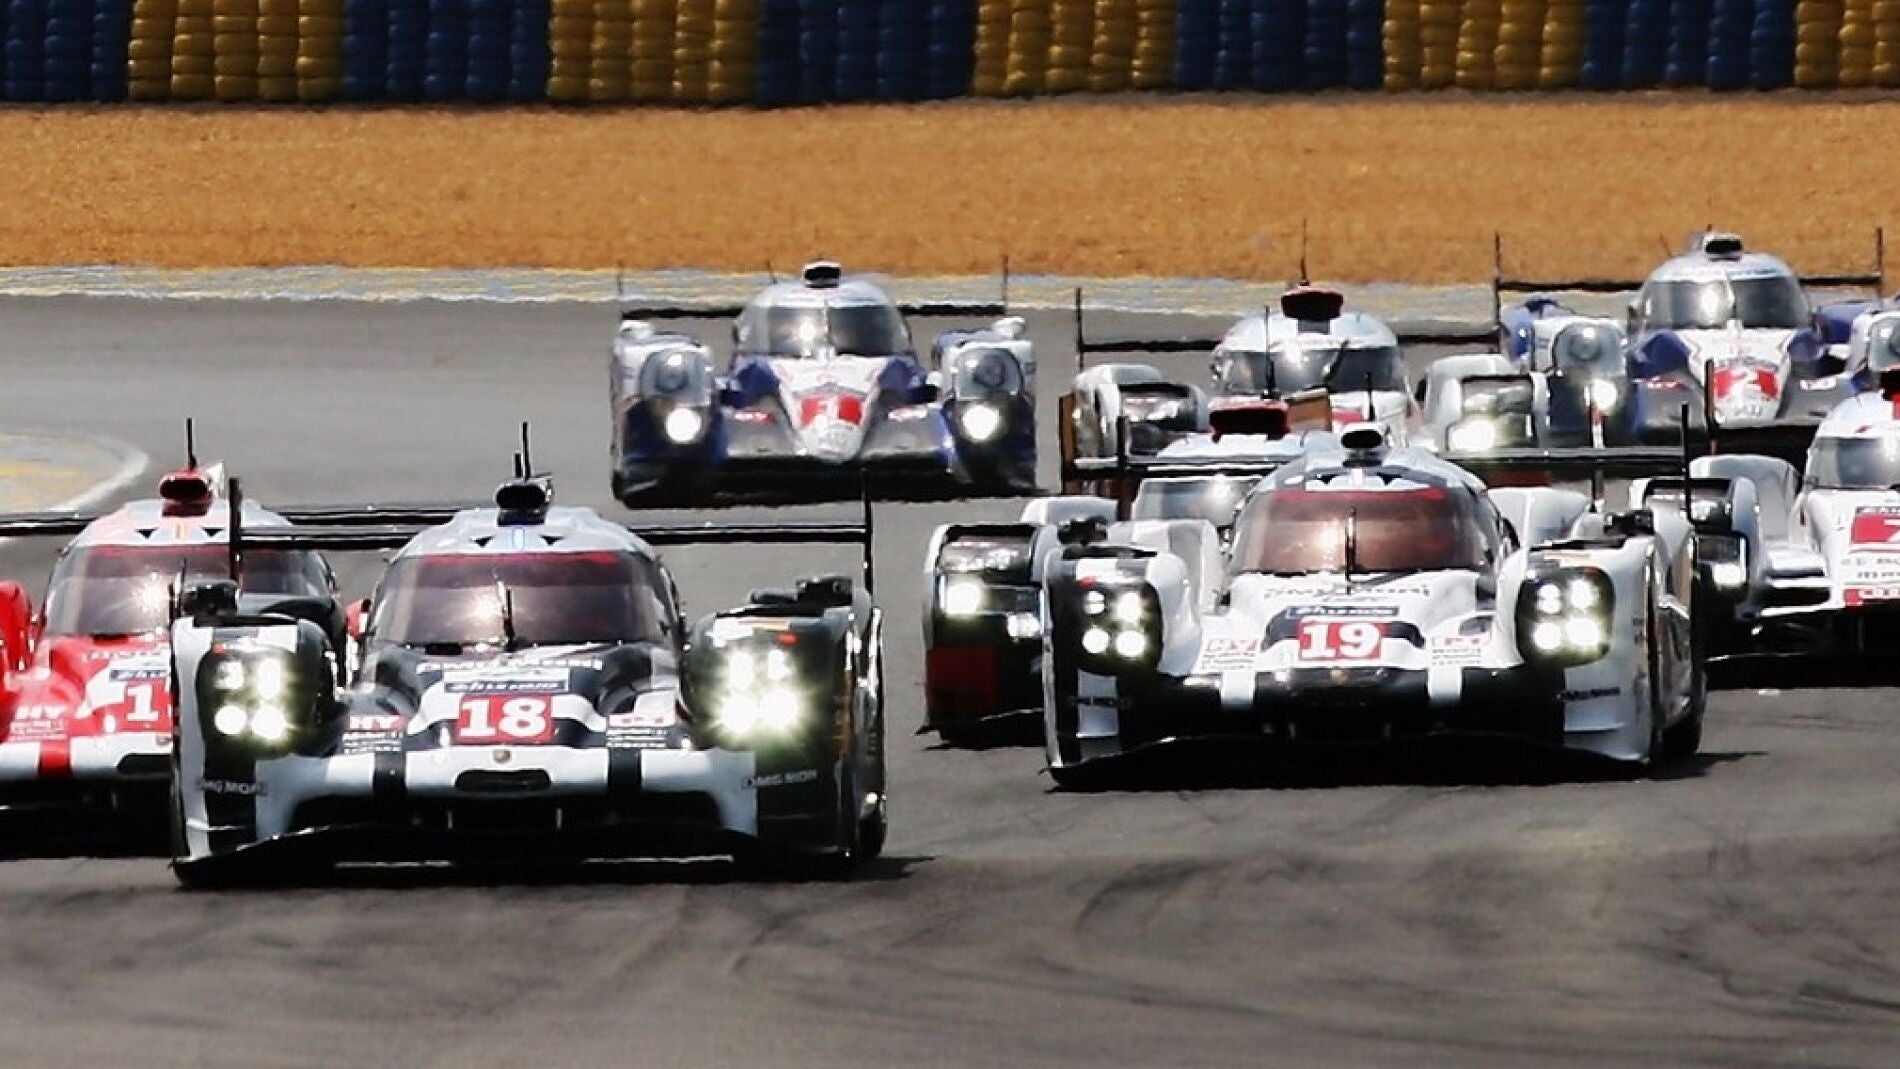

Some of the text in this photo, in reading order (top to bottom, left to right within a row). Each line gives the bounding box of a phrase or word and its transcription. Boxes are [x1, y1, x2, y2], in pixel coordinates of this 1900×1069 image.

[1302, 623, 1380, 658] 19
[127, 684, 172, 722] 1
[460, 698, 546, 736] 18
